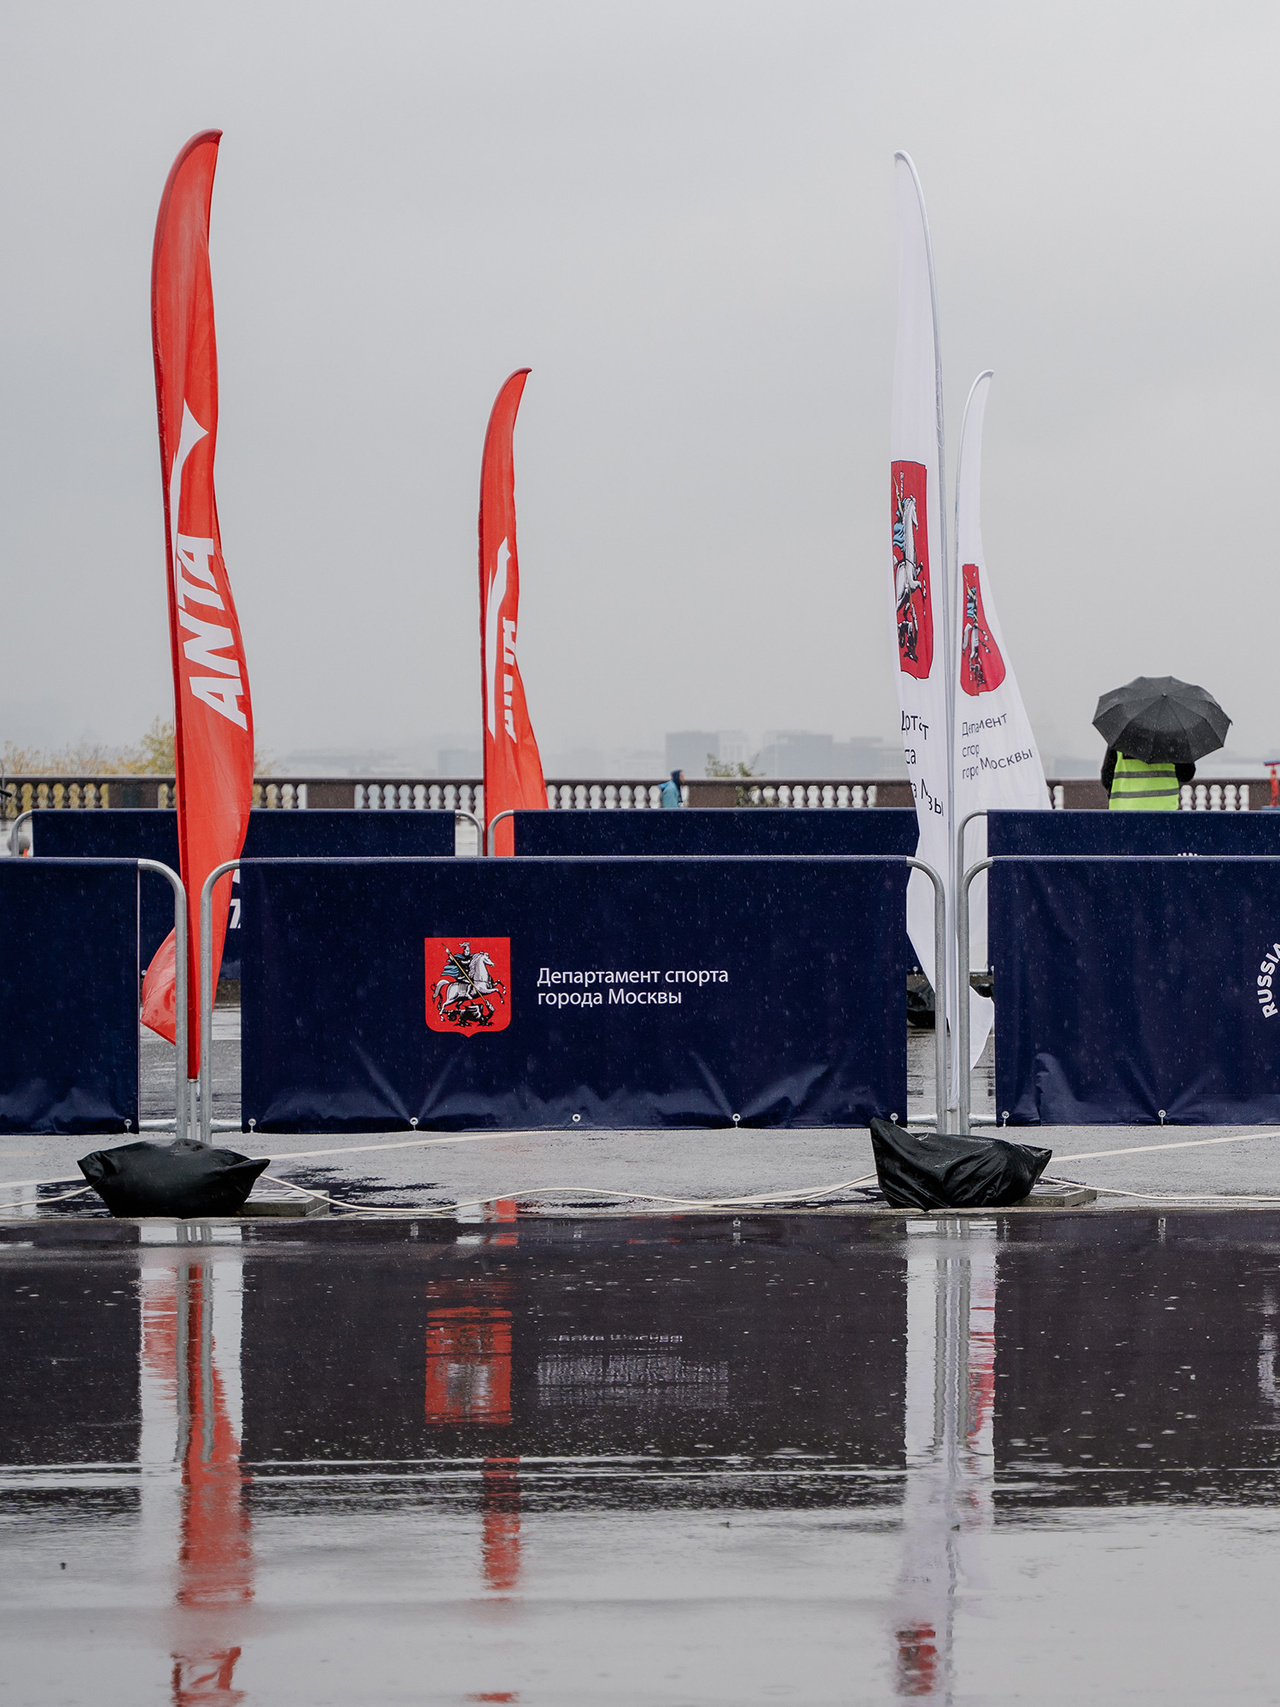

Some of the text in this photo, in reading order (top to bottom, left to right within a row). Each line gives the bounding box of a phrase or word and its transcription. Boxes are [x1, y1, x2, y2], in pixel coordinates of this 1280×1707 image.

[177, 533, 248, 731] ANTA
[980, 748, 1033, 771] Москвы
[537, 967, 729, 987] Департамент спорта
[537, 988, 682, 1009] города Москвы
